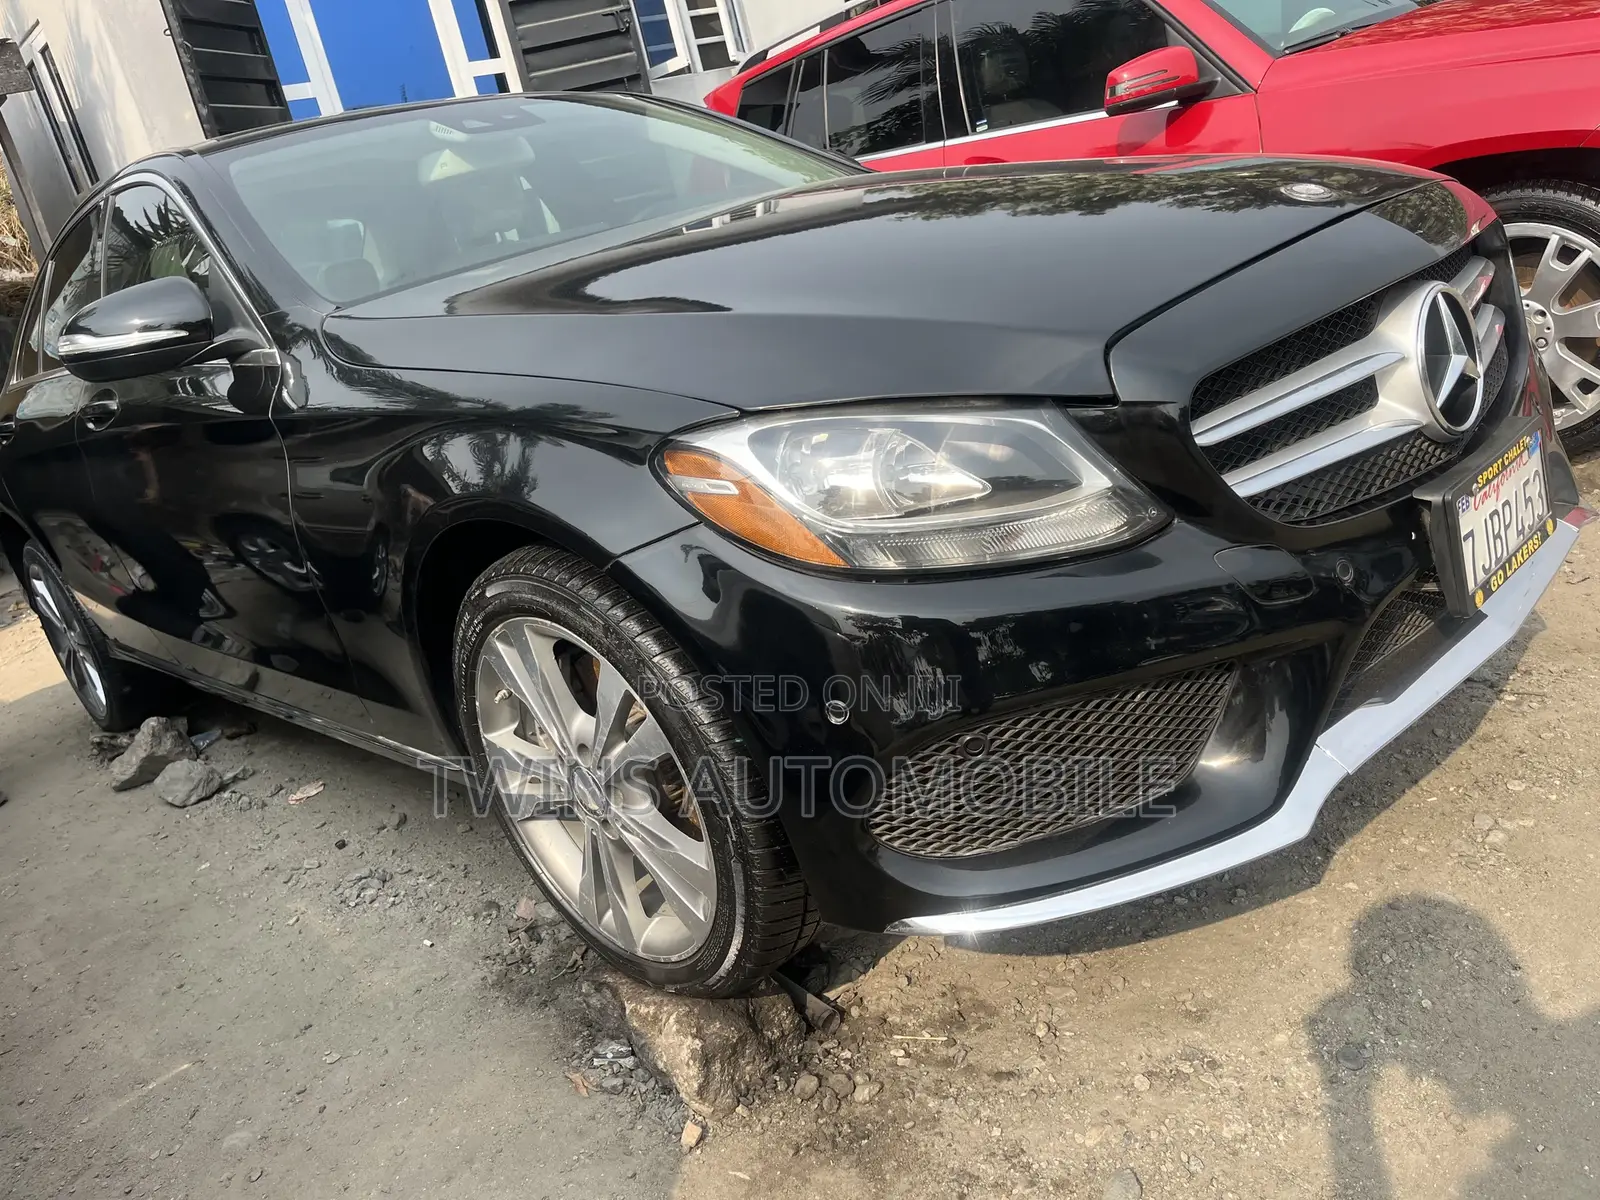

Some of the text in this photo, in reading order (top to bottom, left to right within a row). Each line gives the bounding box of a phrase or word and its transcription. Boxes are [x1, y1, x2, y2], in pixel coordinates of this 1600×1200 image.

[1477, 458, 1503, 488] SPORT
[1503, 435, 1528, 465] CHALET
[1463, 469, 1545, 588] 7JBP453
[1490, 531, 1542, 592] GO LAKERS!
